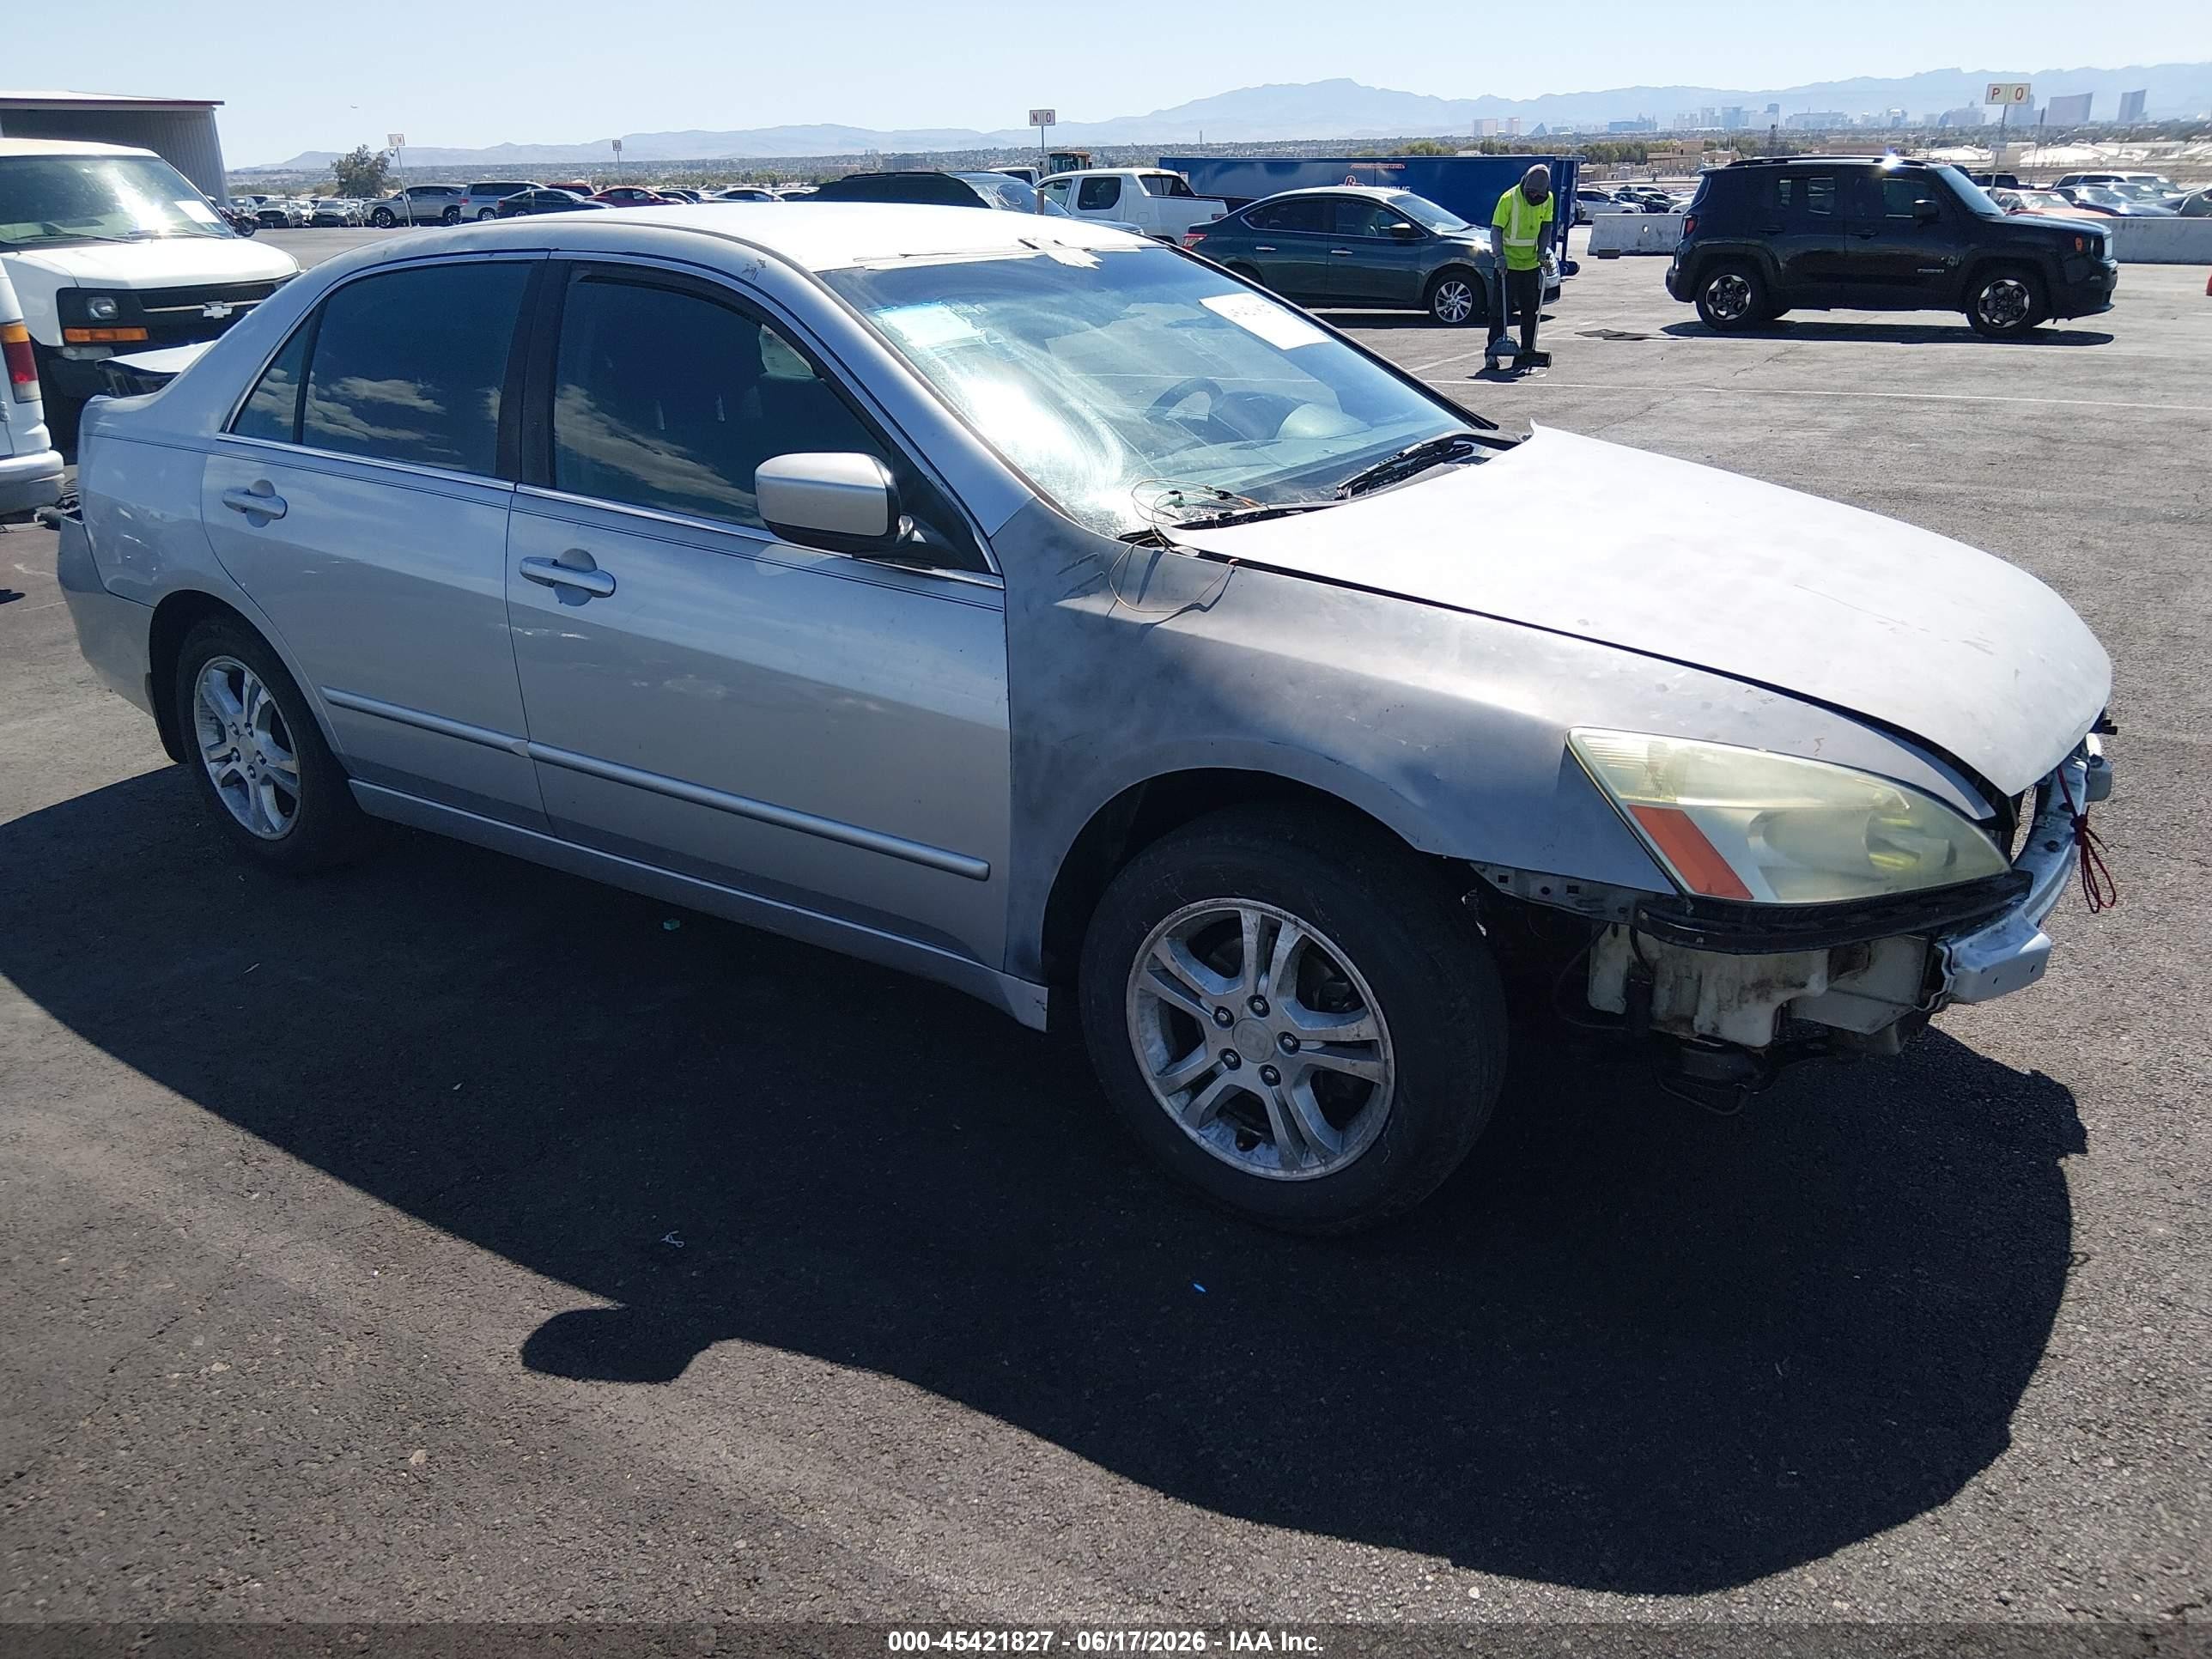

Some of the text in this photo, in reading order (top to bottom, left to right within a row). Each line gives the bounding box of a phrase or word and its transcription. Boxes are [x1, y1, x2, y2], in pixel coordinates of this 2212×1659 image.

[1991, 88, 2001, 100] P
[1032, 112, 1052, 124] N O
